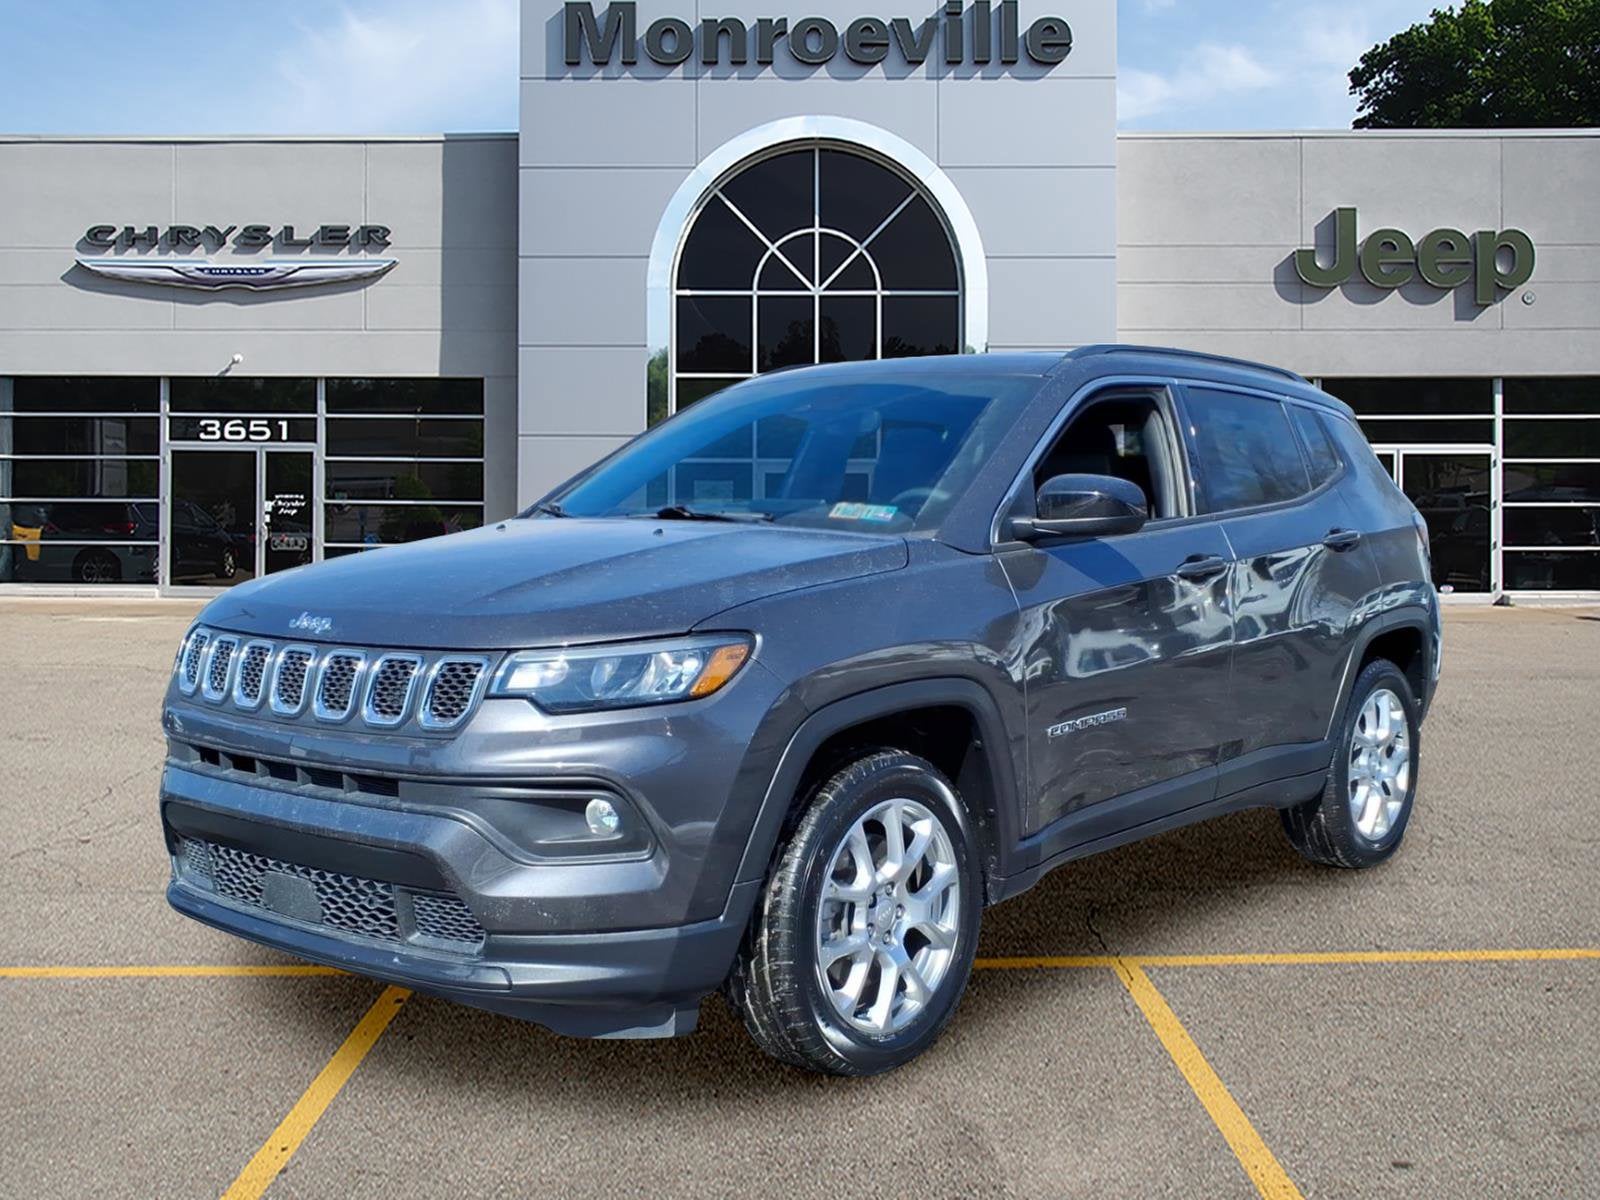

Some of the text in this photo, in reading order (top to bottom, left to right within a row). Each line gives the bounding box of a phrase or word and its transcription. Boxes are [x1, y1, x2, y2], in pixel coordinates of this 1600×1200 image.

[563, 0, 1073, 66] Monroeville
[84, 224, 393, 247] CHRYSLER
[1294, 206, 1536, 305] Jeep
[199, 419, 288, 441] 3651
[288, 611, 333, 635] Jeep
